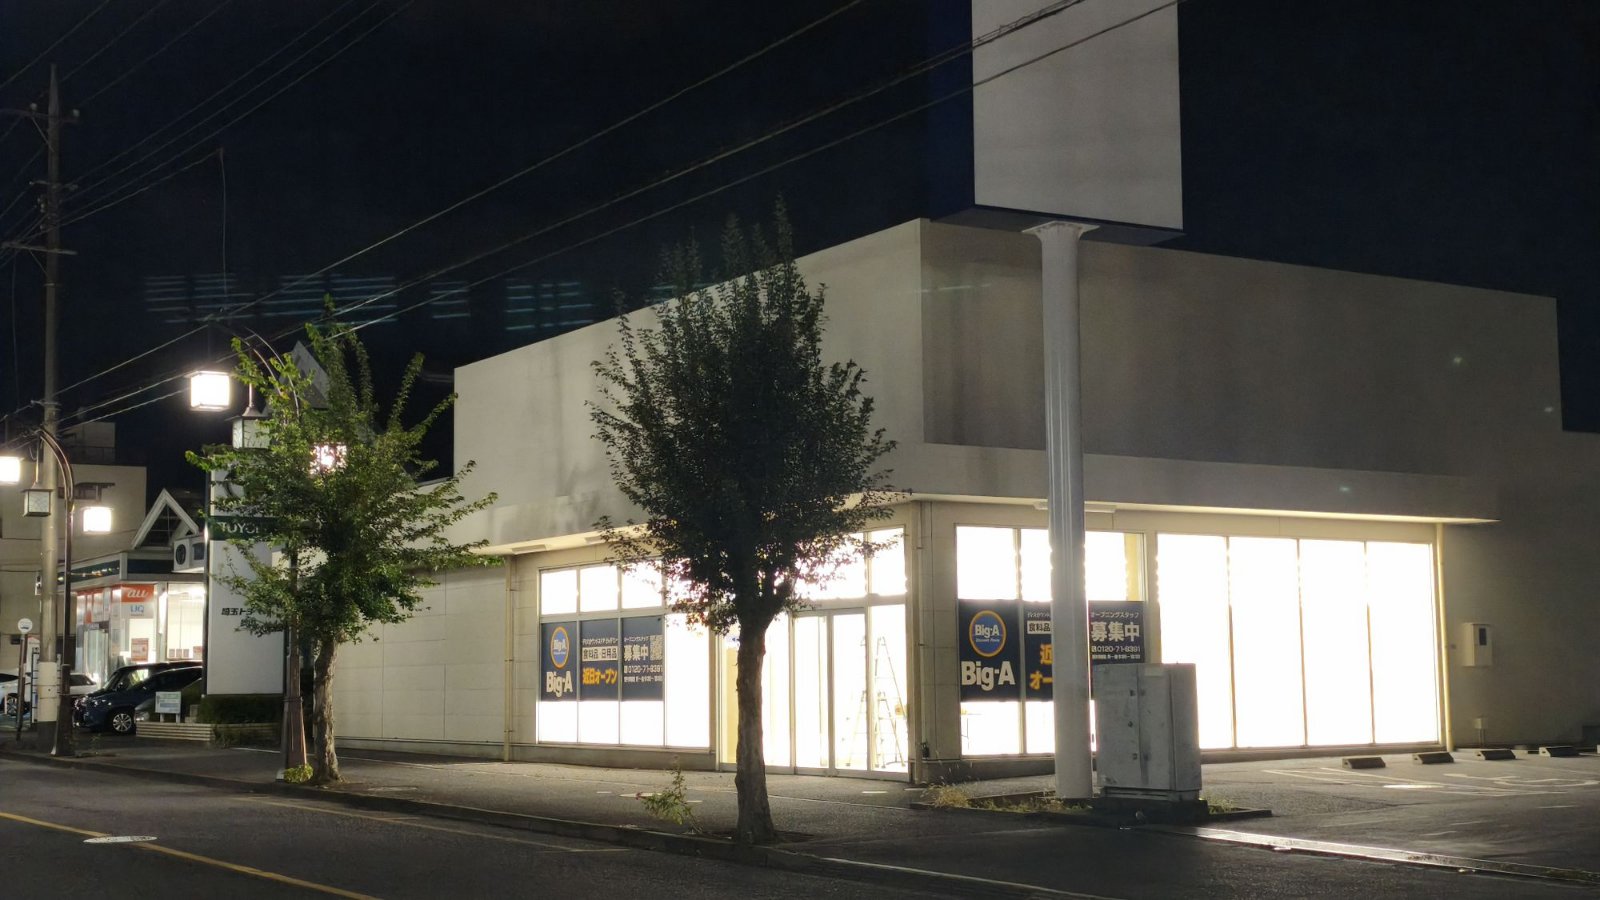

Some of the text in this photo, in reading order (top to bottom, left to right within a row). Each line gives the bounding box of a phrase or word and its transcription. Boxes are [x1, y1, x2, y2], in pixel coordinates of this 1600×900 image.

[127, 590, 148, 598] au
[130, 604, 145, 614] UQ
[1091, 621, 1140, 642] 募集中
[624, 644, 649, 661] 募集中
[582, 667, 618, 685] 近日オープン
